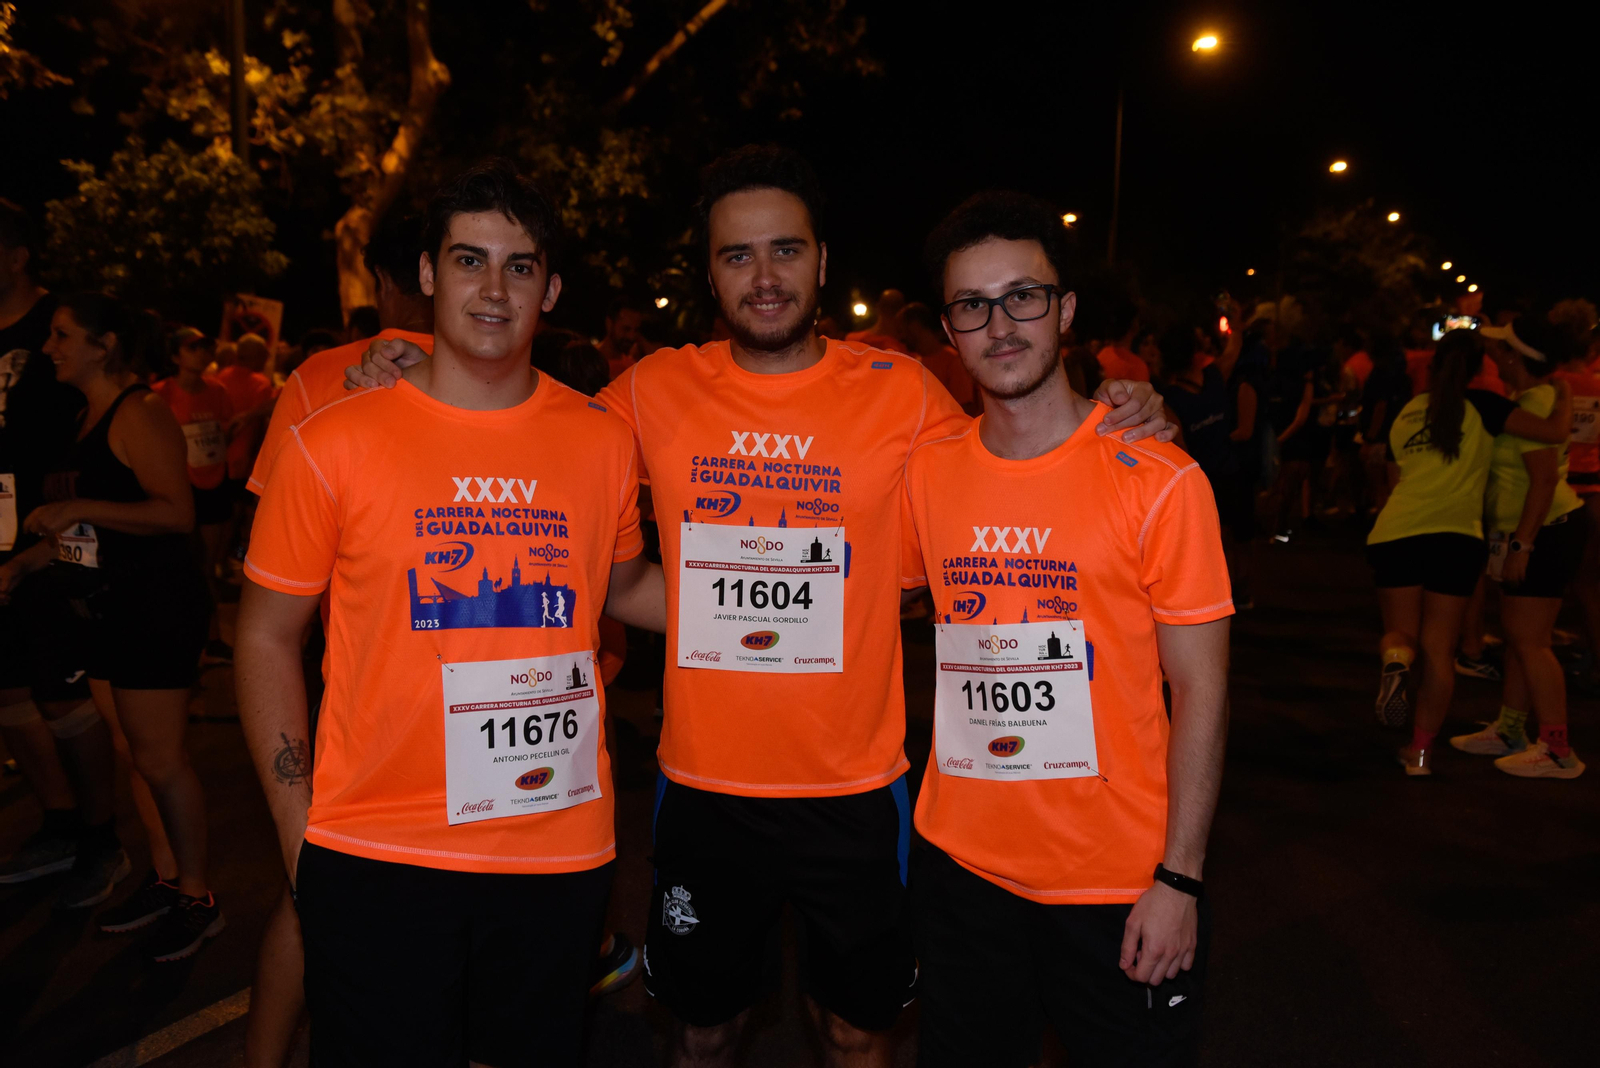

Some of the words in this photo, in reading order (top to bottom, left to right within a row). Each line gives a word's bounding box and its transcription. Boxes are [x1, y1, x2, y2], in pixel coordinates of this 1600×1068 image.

[728, 430, 814, 460] XXXV
[692, 456, 756, 472] CARRERA
[764, 462, 842, 477] NOCTURNA
[452, 477, 538, 504] XXXV
[700, 470, 841, 494] GUADALQUIVIR
[414, 507, 485, 519] CARRERA
[492, 508, 568, 522] NOCTURNA
[426, 521, 569, 538] GUADALQUIVIR
[970, 526, 1052, 554] XXXV
[943, 557, 998, 569] CARRERA
[1004, 558, 1078, 573] NOCTURNA
[951, 571, 1078, 590] GUADALQUIVIR
[712, 578, 813, 610] 11604
[414, 619, 440, 628] 2023
[794, 656, 834, 664] Cruzcampo
[542, 694, 574, 704] GUADALQUIVIR
[962, 680, 1056, 712] 11603
[480, 709, 578, 749] 11676
[970, 718, 988, 726] DANIEL
[989, 718, 1006, 727] FRÍAS
[493, 754, 528, 764] ANTONIO
[530, 750, 559, 760] PECELLIN
[1044, 760, 1088, 770] Cruzcampo
[568, 784, 594, 798] Cruzcampo
